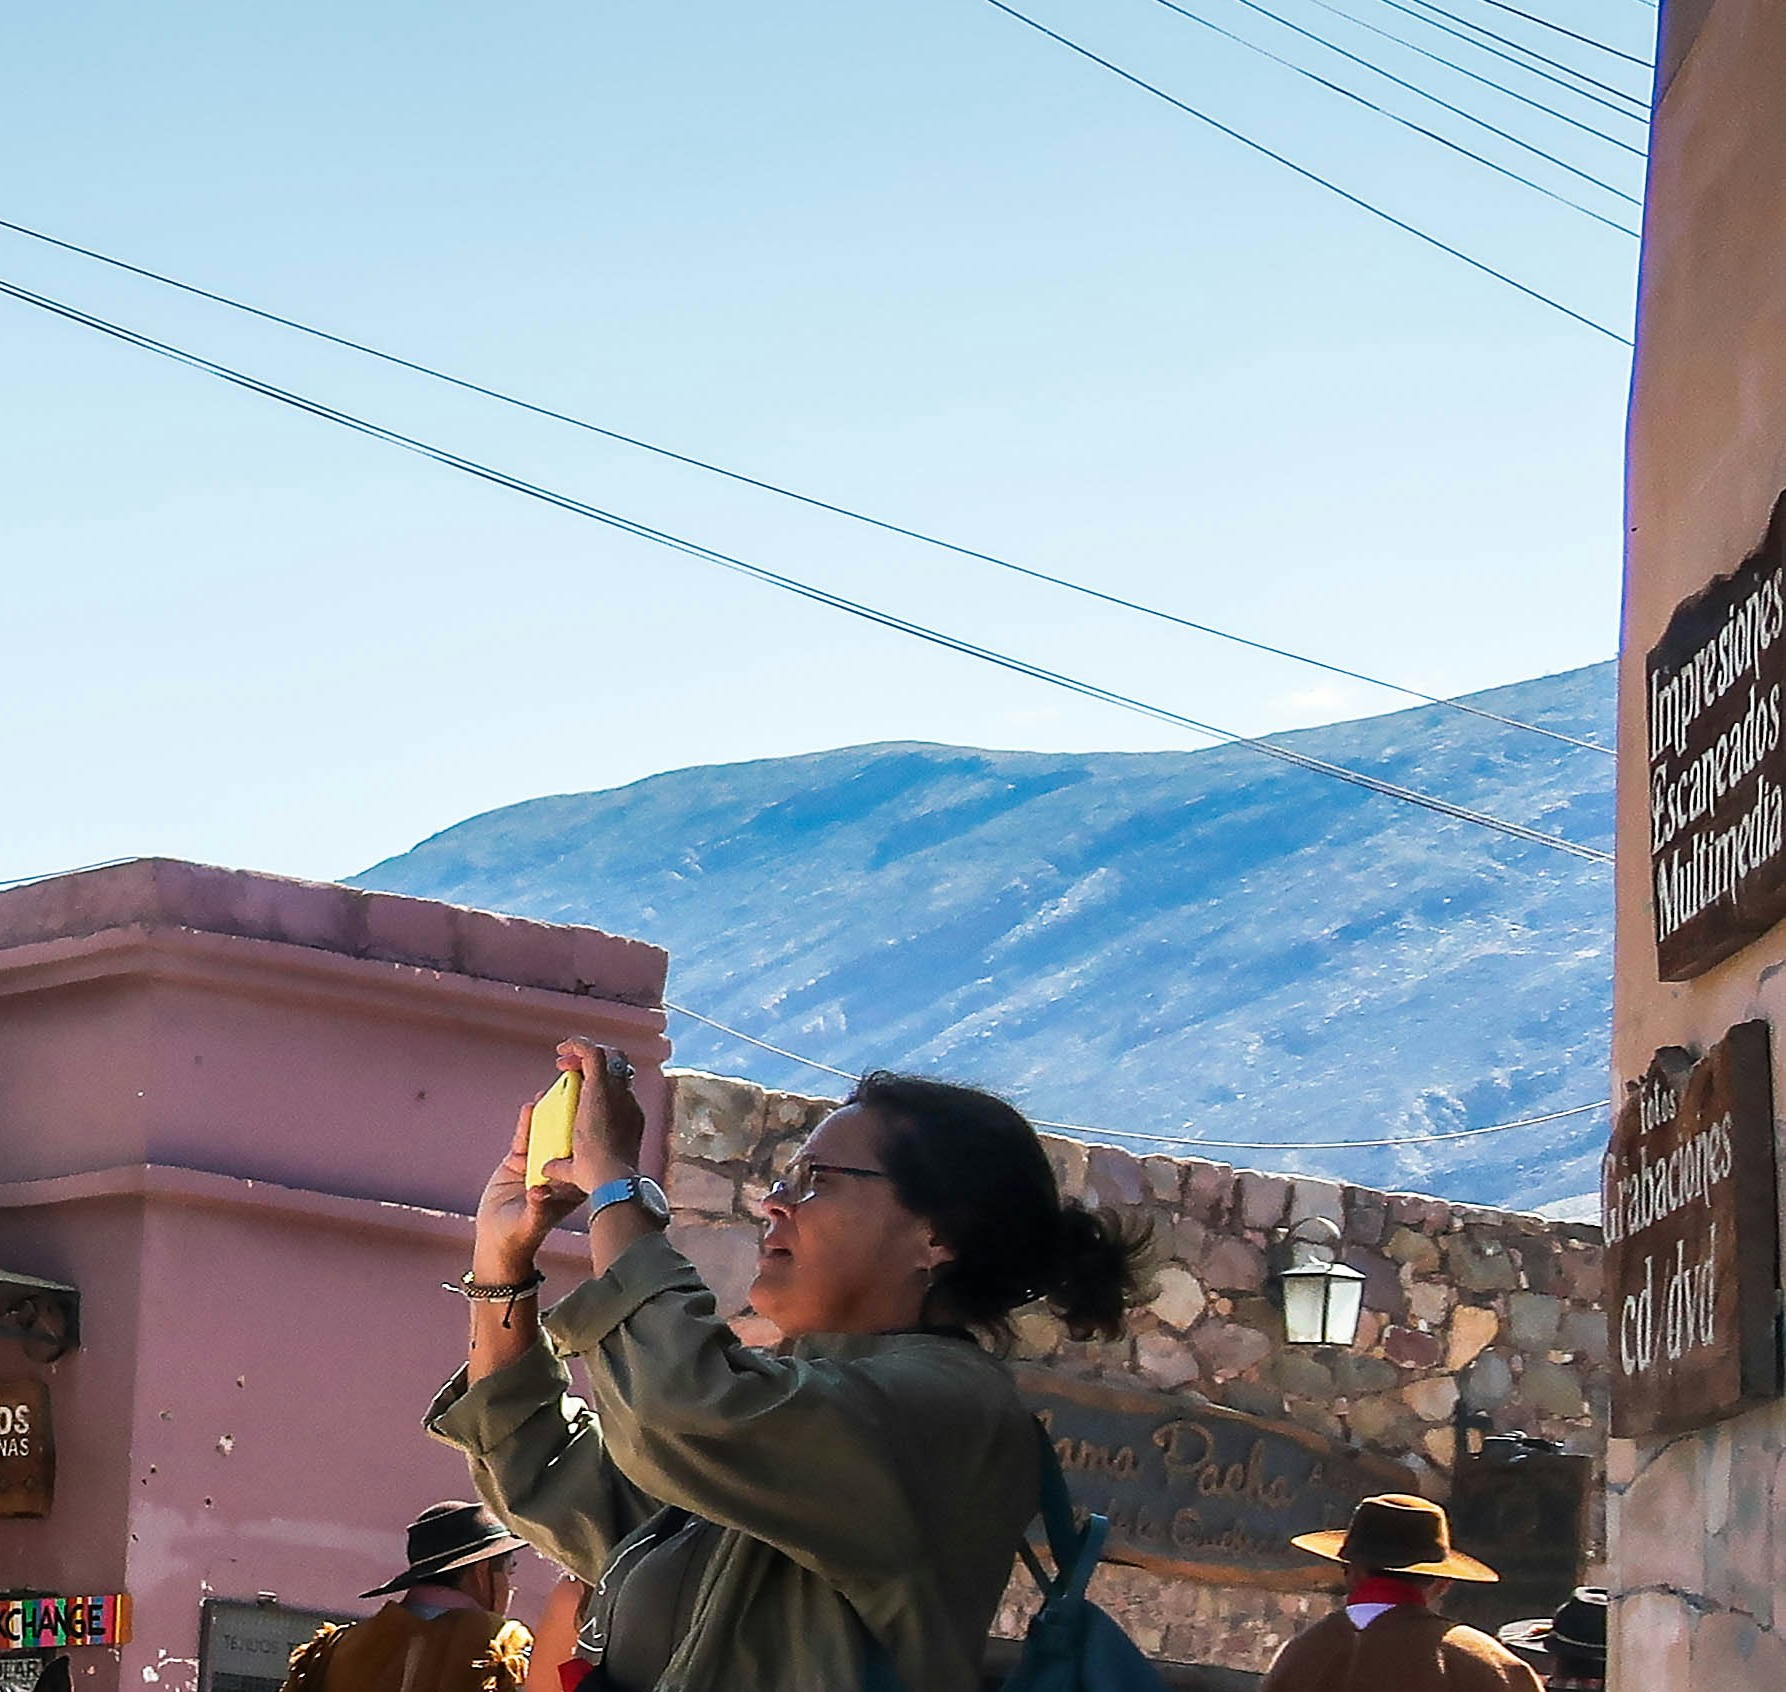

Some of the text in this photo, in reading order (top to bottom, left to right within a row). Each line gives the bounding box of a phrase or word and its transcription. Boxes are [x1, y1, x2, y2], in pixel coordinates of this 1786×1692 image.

[1650, 566, 1784, 763] Impresiones
[1651, 682, 1782, 856] Escaneados
[1656, 772, 1783, 944] Multimedia
[1603, 1110, 1733, 1248] Grabaciones
